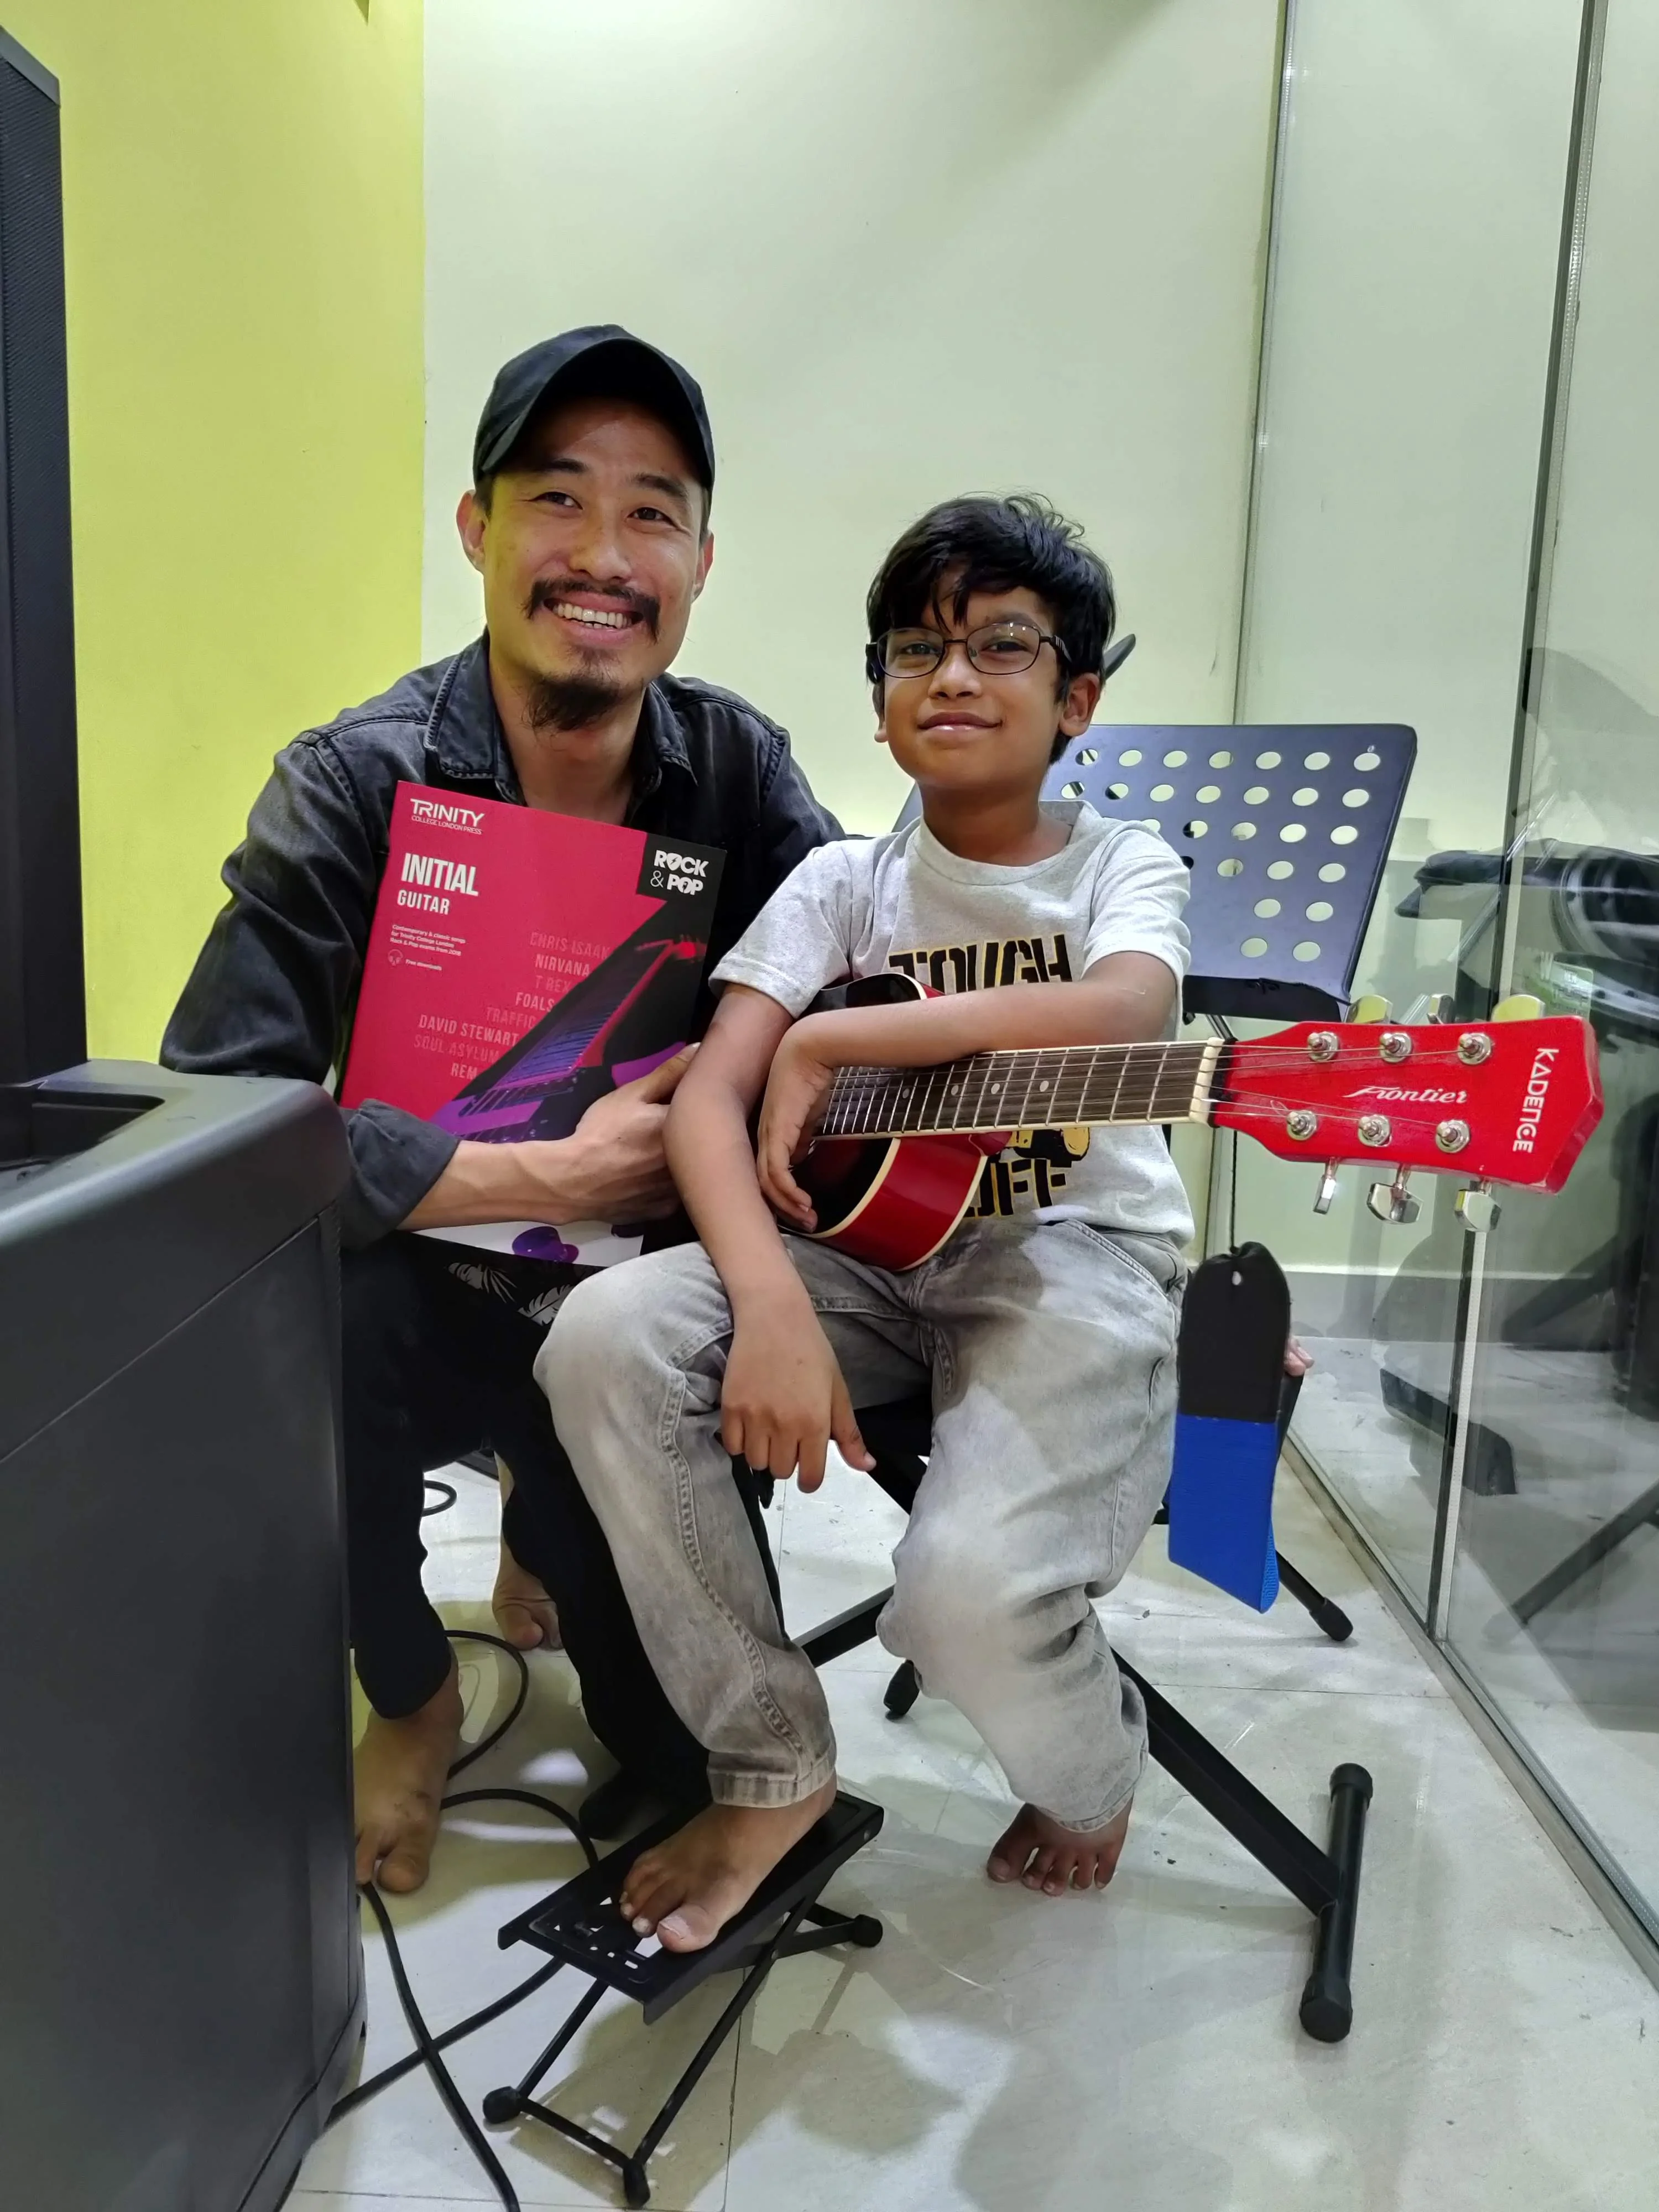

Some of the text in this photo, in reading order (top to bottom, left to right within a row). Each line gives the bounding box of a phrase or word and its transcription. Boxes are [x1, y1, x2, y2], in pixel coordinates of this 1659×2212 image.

[410, 798, 485, 827] TRINITY
[411, 815, 482, 835] COLLEGE LONDON PRESS
[401, 852, 479, 896] INITIAL
[654, 849, 709, 878] ROCK
[650, 870, 703, 895] & POP
[397, 889, 450, 915] GUITAR
[535, 953, 590, 977] NIRVANA
[515, 992, 555, 1013] FOALS
[419, 1014, 519, 1047] DAVID STEWART
[1342, 1084, 1467, 1104] Frontier
[1512, 1048, 1559, 1154] KADENCE
